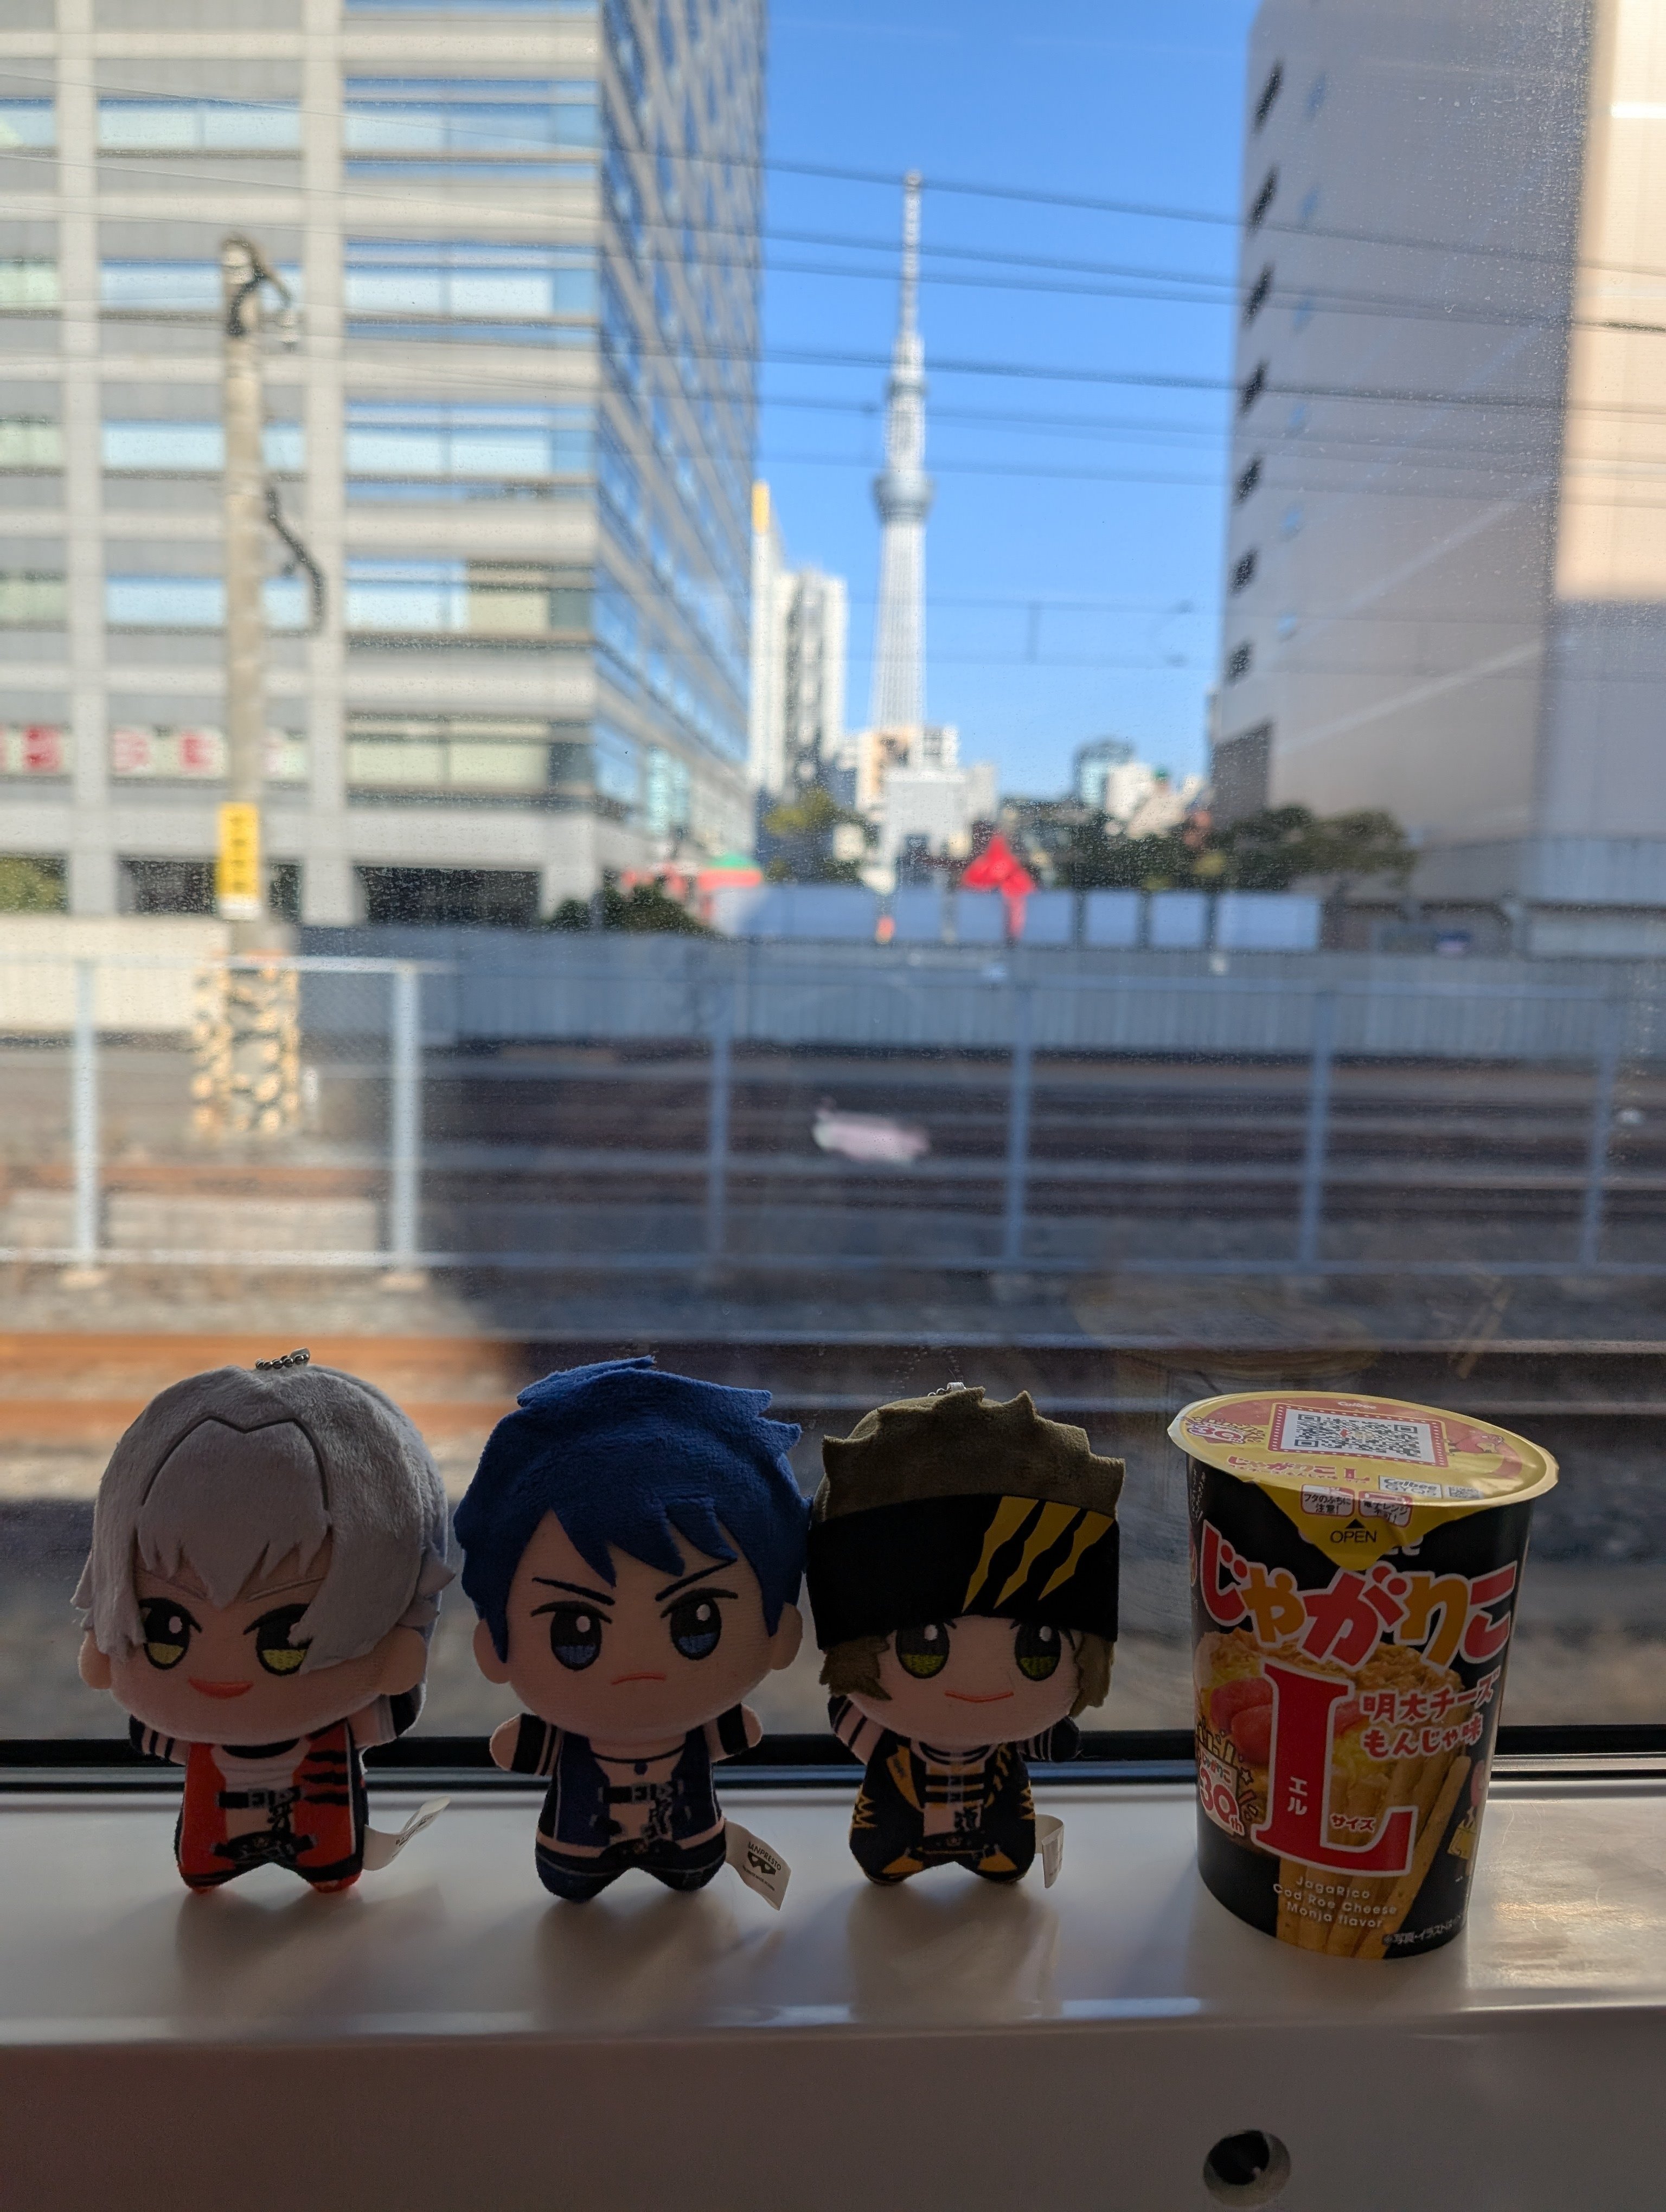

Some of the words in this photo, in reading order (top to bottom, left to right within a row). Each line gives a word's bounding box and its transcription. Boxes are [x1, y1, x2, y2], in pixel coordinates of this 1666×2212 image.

[1330, 1530, 1377, 1544] OPEN
[1201, 1519, 1517, 1675] じゃがりこ
[1360, 1666, 1501, 1726] 明太チーズ
[1361, 1712, 1483, 1760] もんじゃ味
[1251, 1662, 1418, 1876] L
[1287, 1776, 1308, 1815] エル
[1330, 1813, 1376, 1834] サイズ
[1273, 1883, 1302, 1901] Cod
[1308, 1894, 1336, 1909] Roe
[1342, 1901, 1397, 1915] Cheese
[1286, 1900, 1333, 1922] Monja
[1338, 1914, 1383, 1928] flavor
